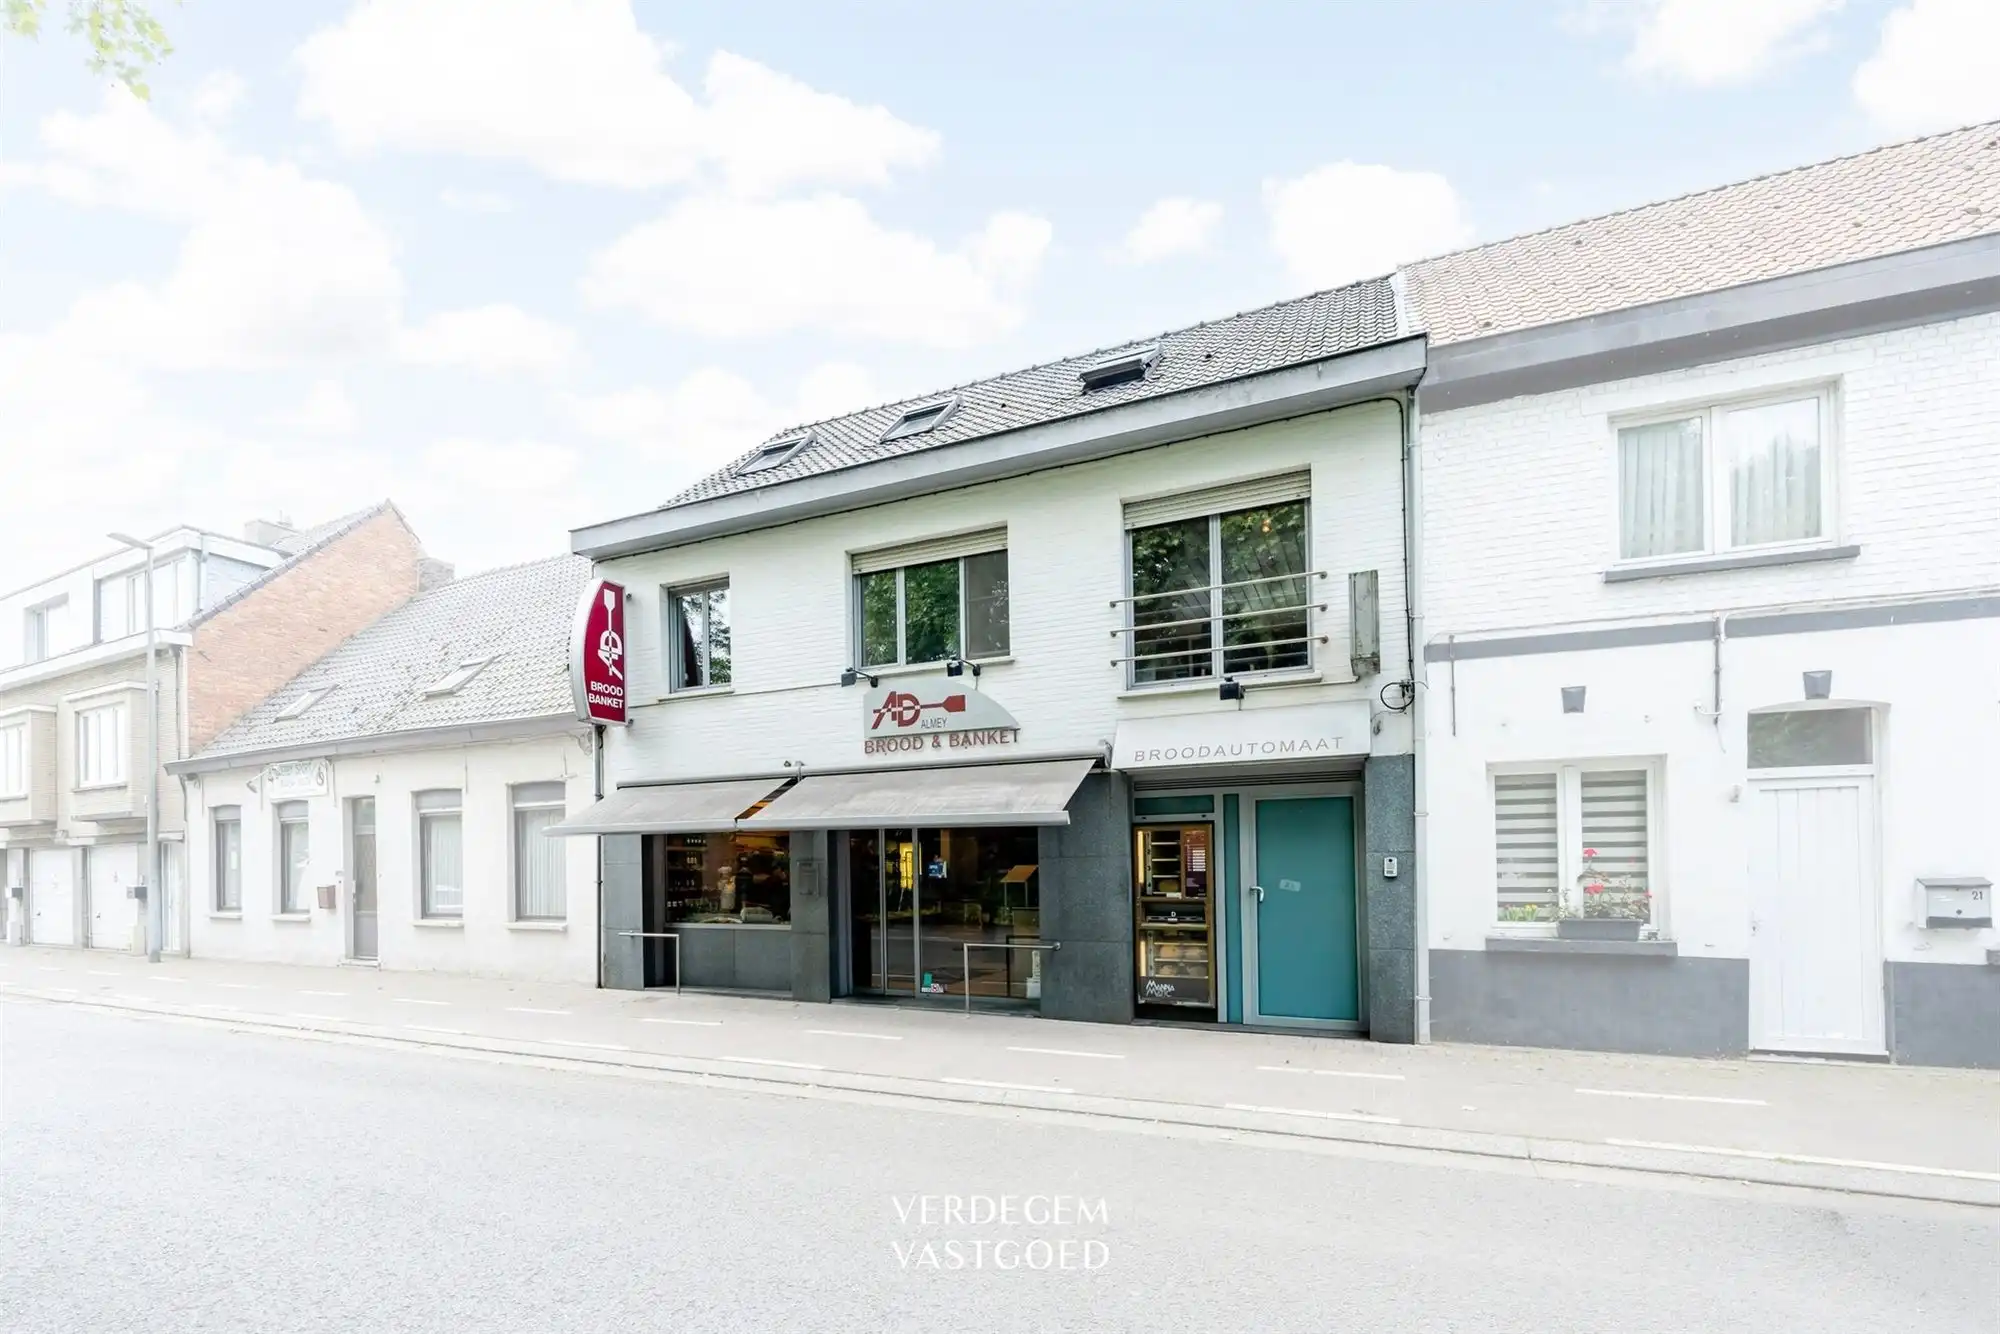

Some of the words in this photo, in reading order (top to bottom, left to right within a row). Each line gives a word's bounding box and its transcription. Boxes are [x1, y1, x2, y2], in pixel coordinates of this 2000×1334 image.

[590, 680, 623, 697] BROOD
[588, 693, 624, 709] BANKET
[920, 717, 948, 729] ALMEY
[864, 736, 924, 755] BROOD
[931, 734, 941, 749] &
[949, 728, 1021, 749] BANKET
[1134, 736, 1343, 762] BROODAUTOMAAT
[1971, 890, 1983, 901] 21
